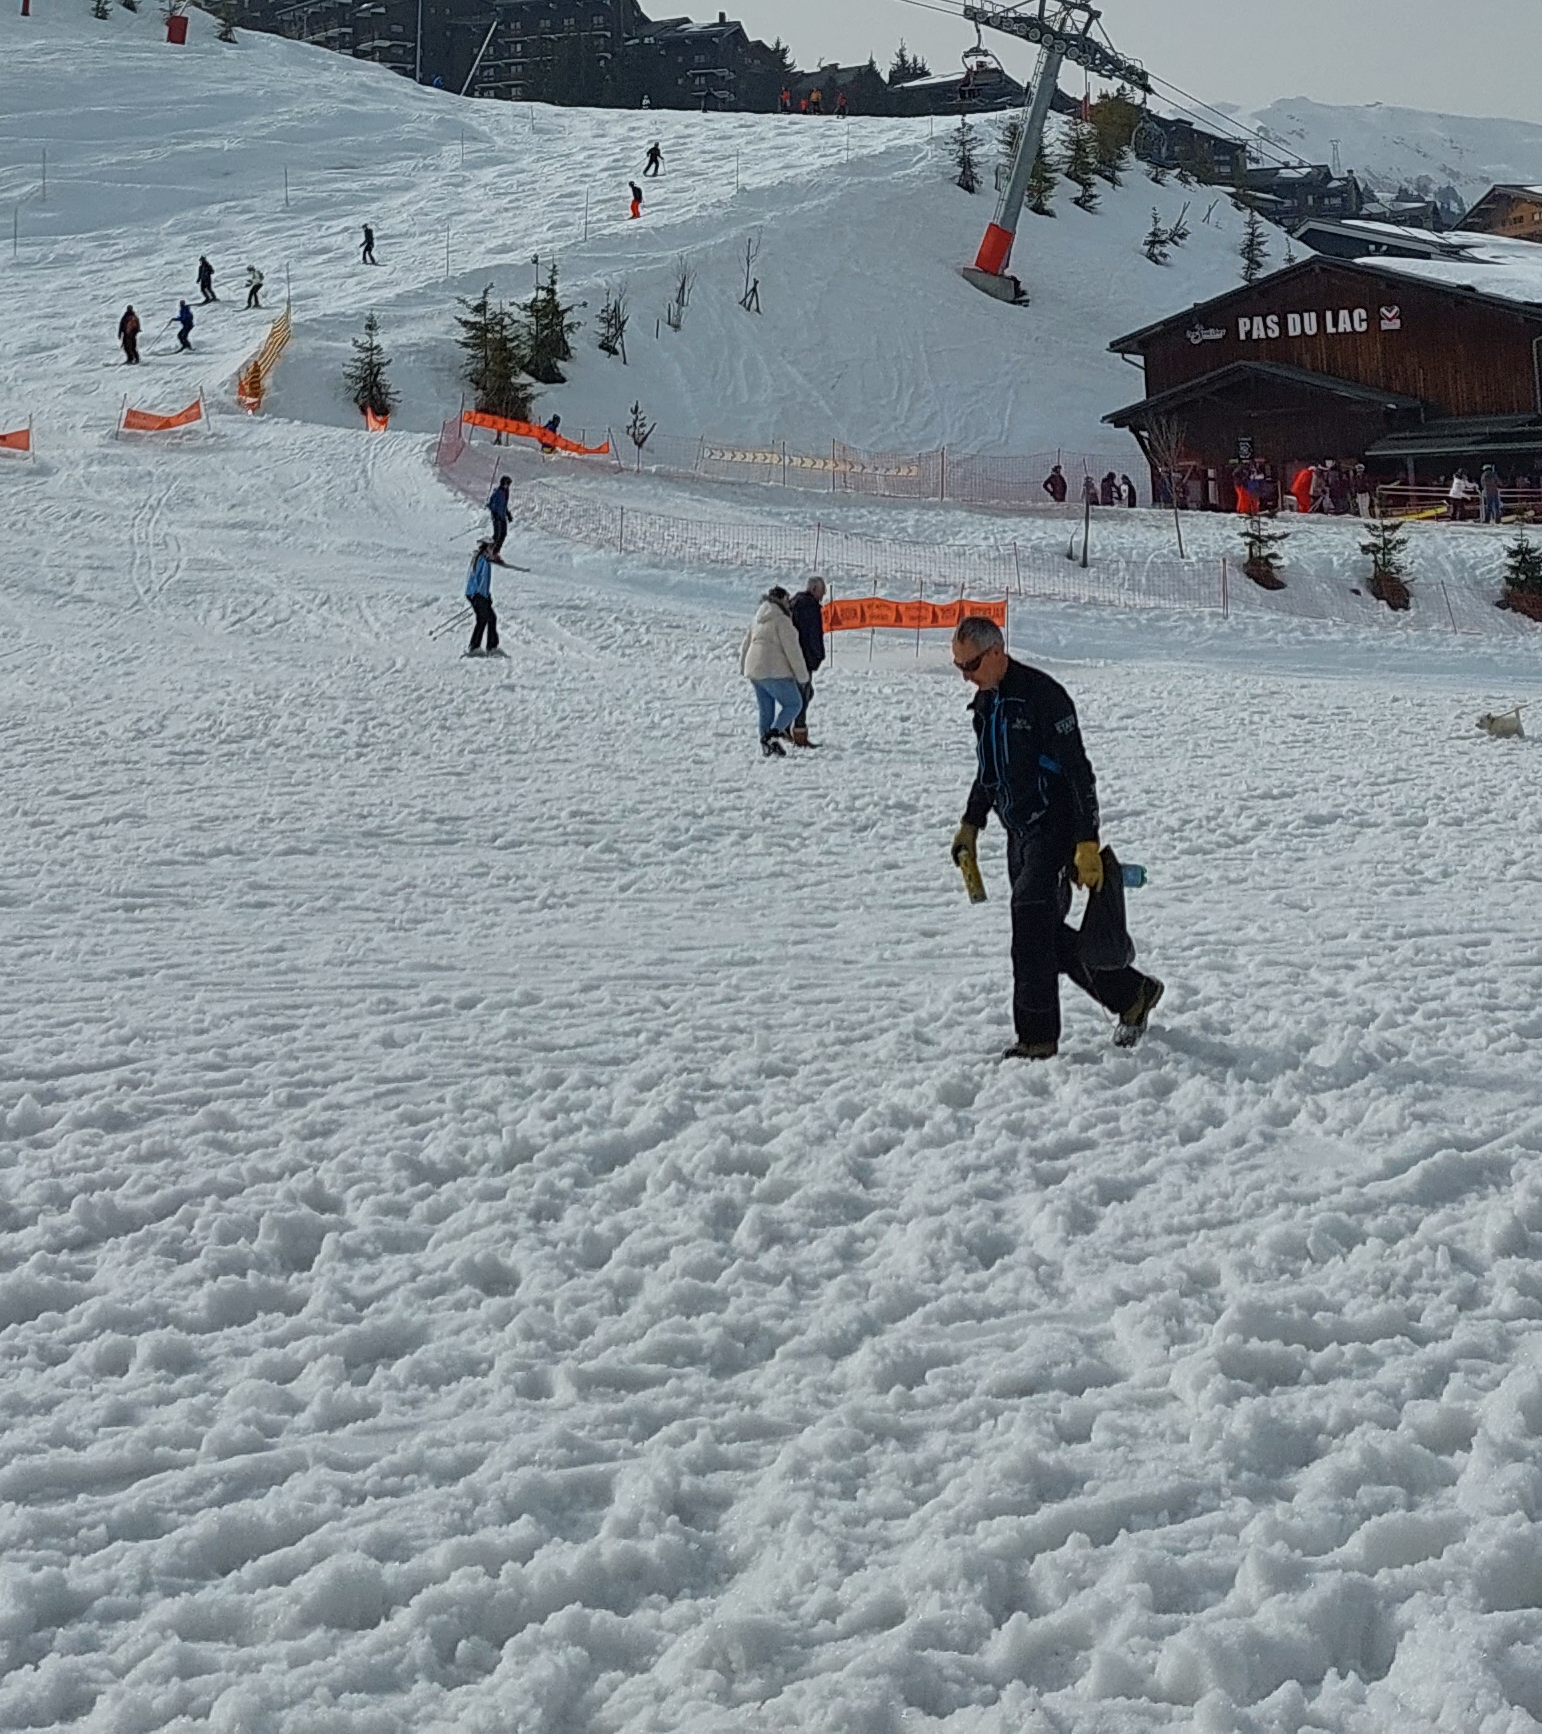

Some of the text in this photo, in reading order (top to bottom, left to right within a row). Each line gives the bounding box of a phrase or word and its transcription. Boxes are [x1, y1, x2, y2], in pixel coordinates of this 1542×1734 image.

[1237, 314, 1281, 341] PAS
[1286, 311, 1318, 337] DU
[1325, 308, 1368, 334] LAC
